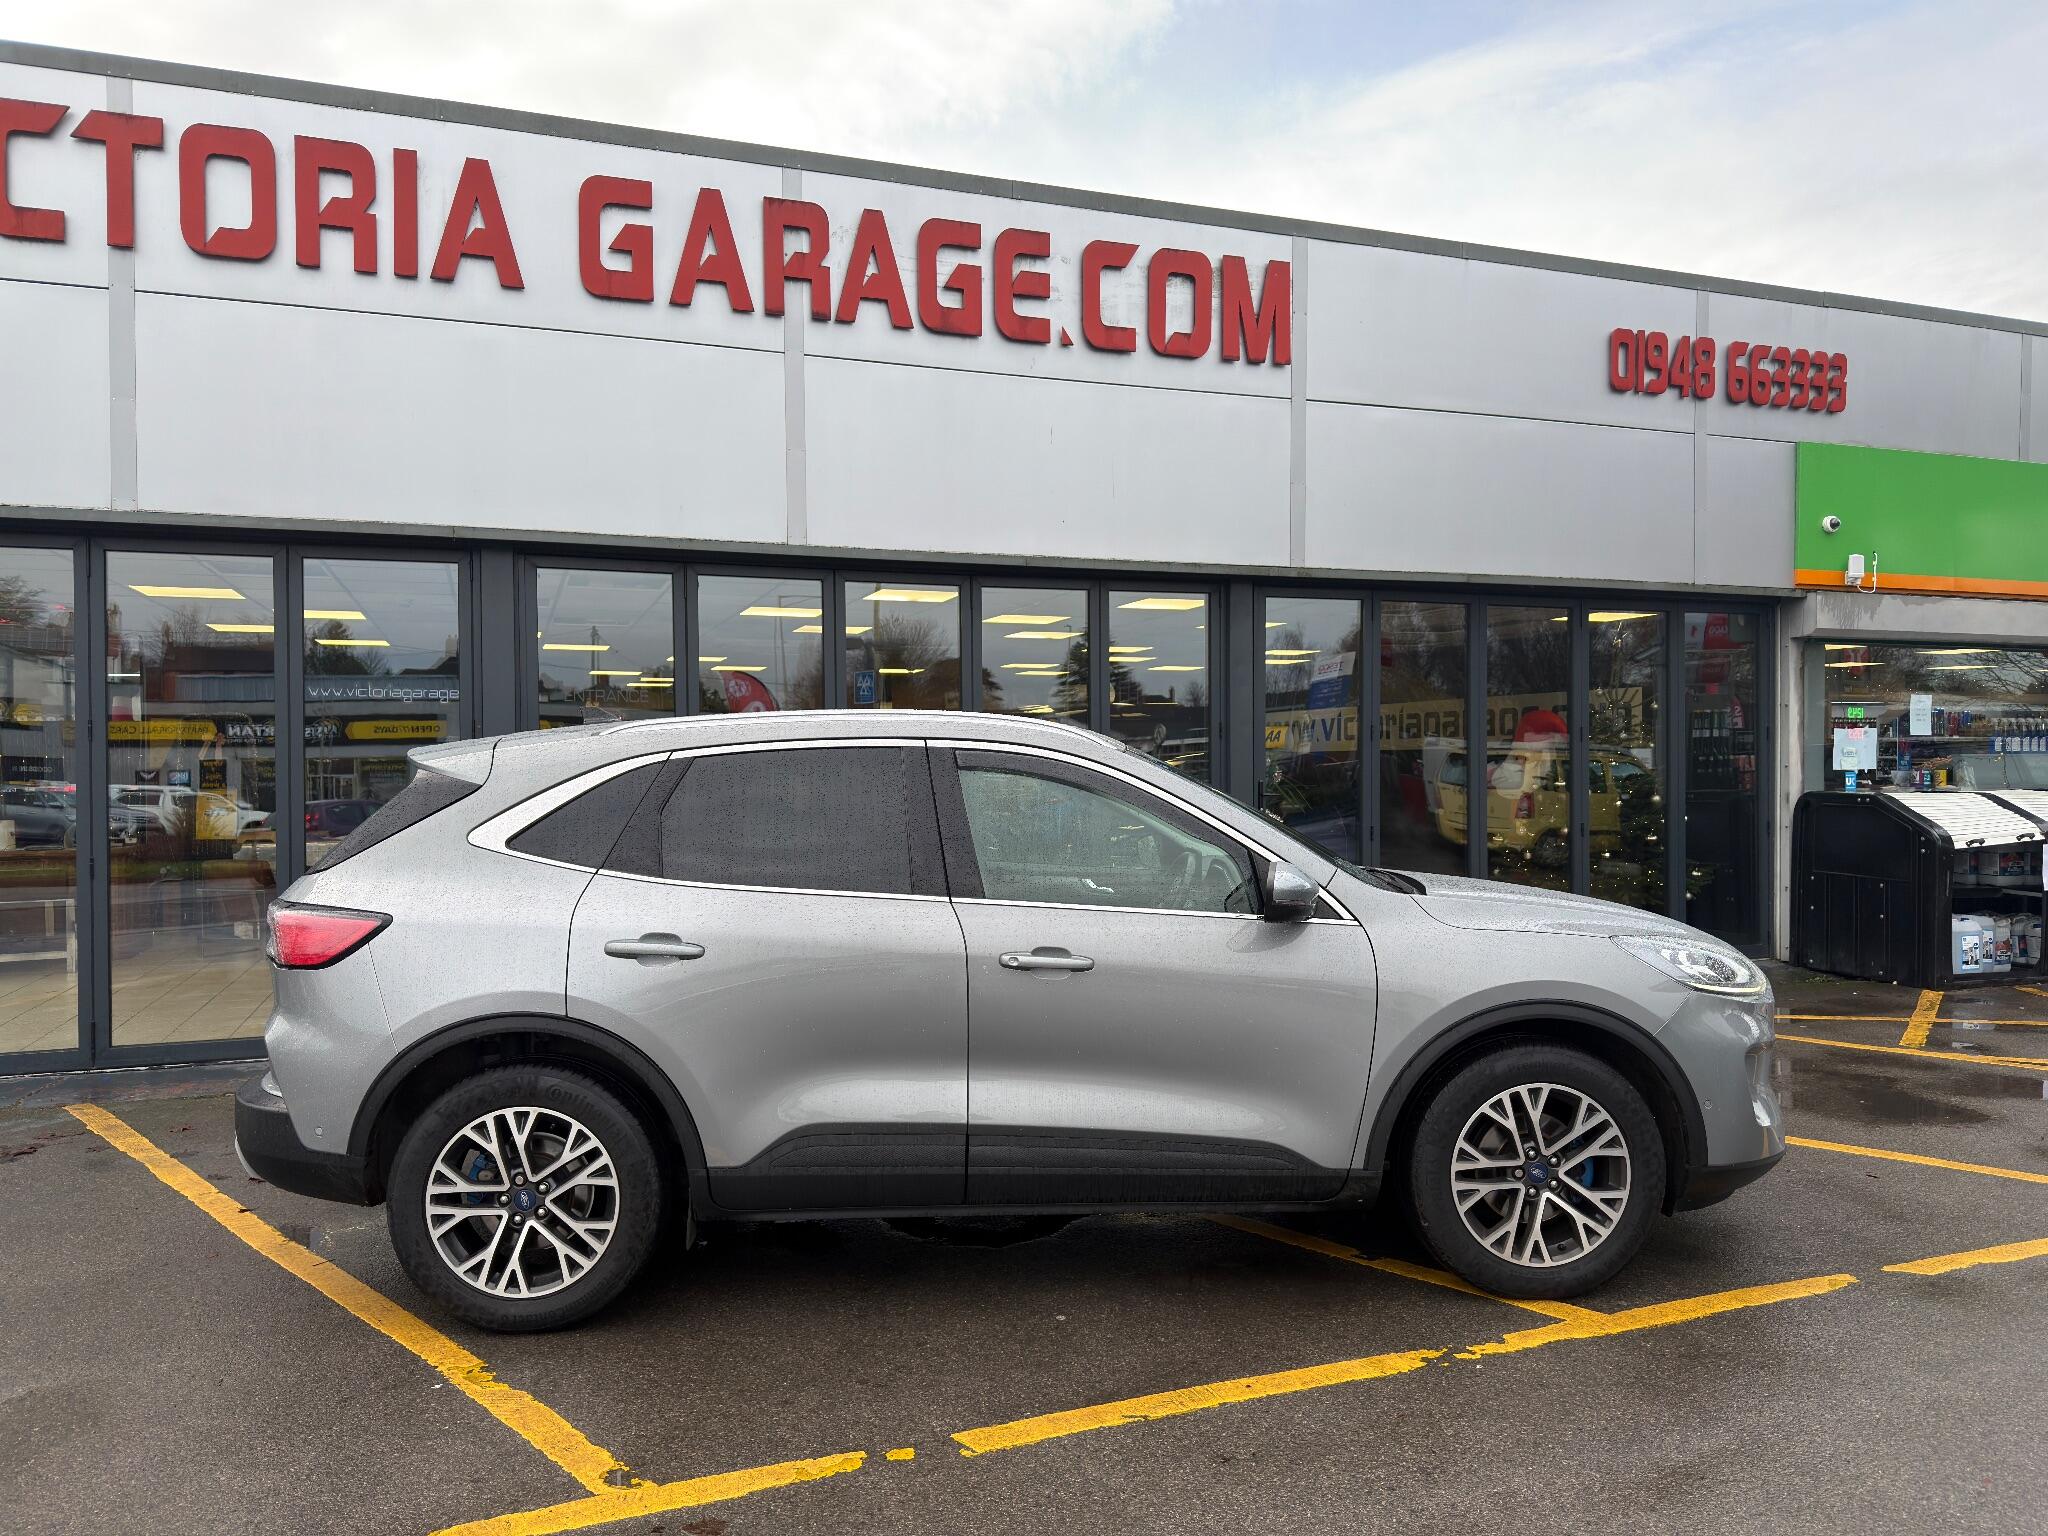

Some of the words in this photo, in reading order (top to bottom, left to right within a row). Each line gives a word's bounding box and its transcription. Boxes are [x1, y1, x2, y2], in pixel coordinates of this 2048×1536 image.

[578, 175, 1292, 366] GARAGE.COM
[1610, 328, 1716, 399] 01948
[1727, 341, 1848, 413] 663333
[308, 683, 460, 703] www.victoriagarage
